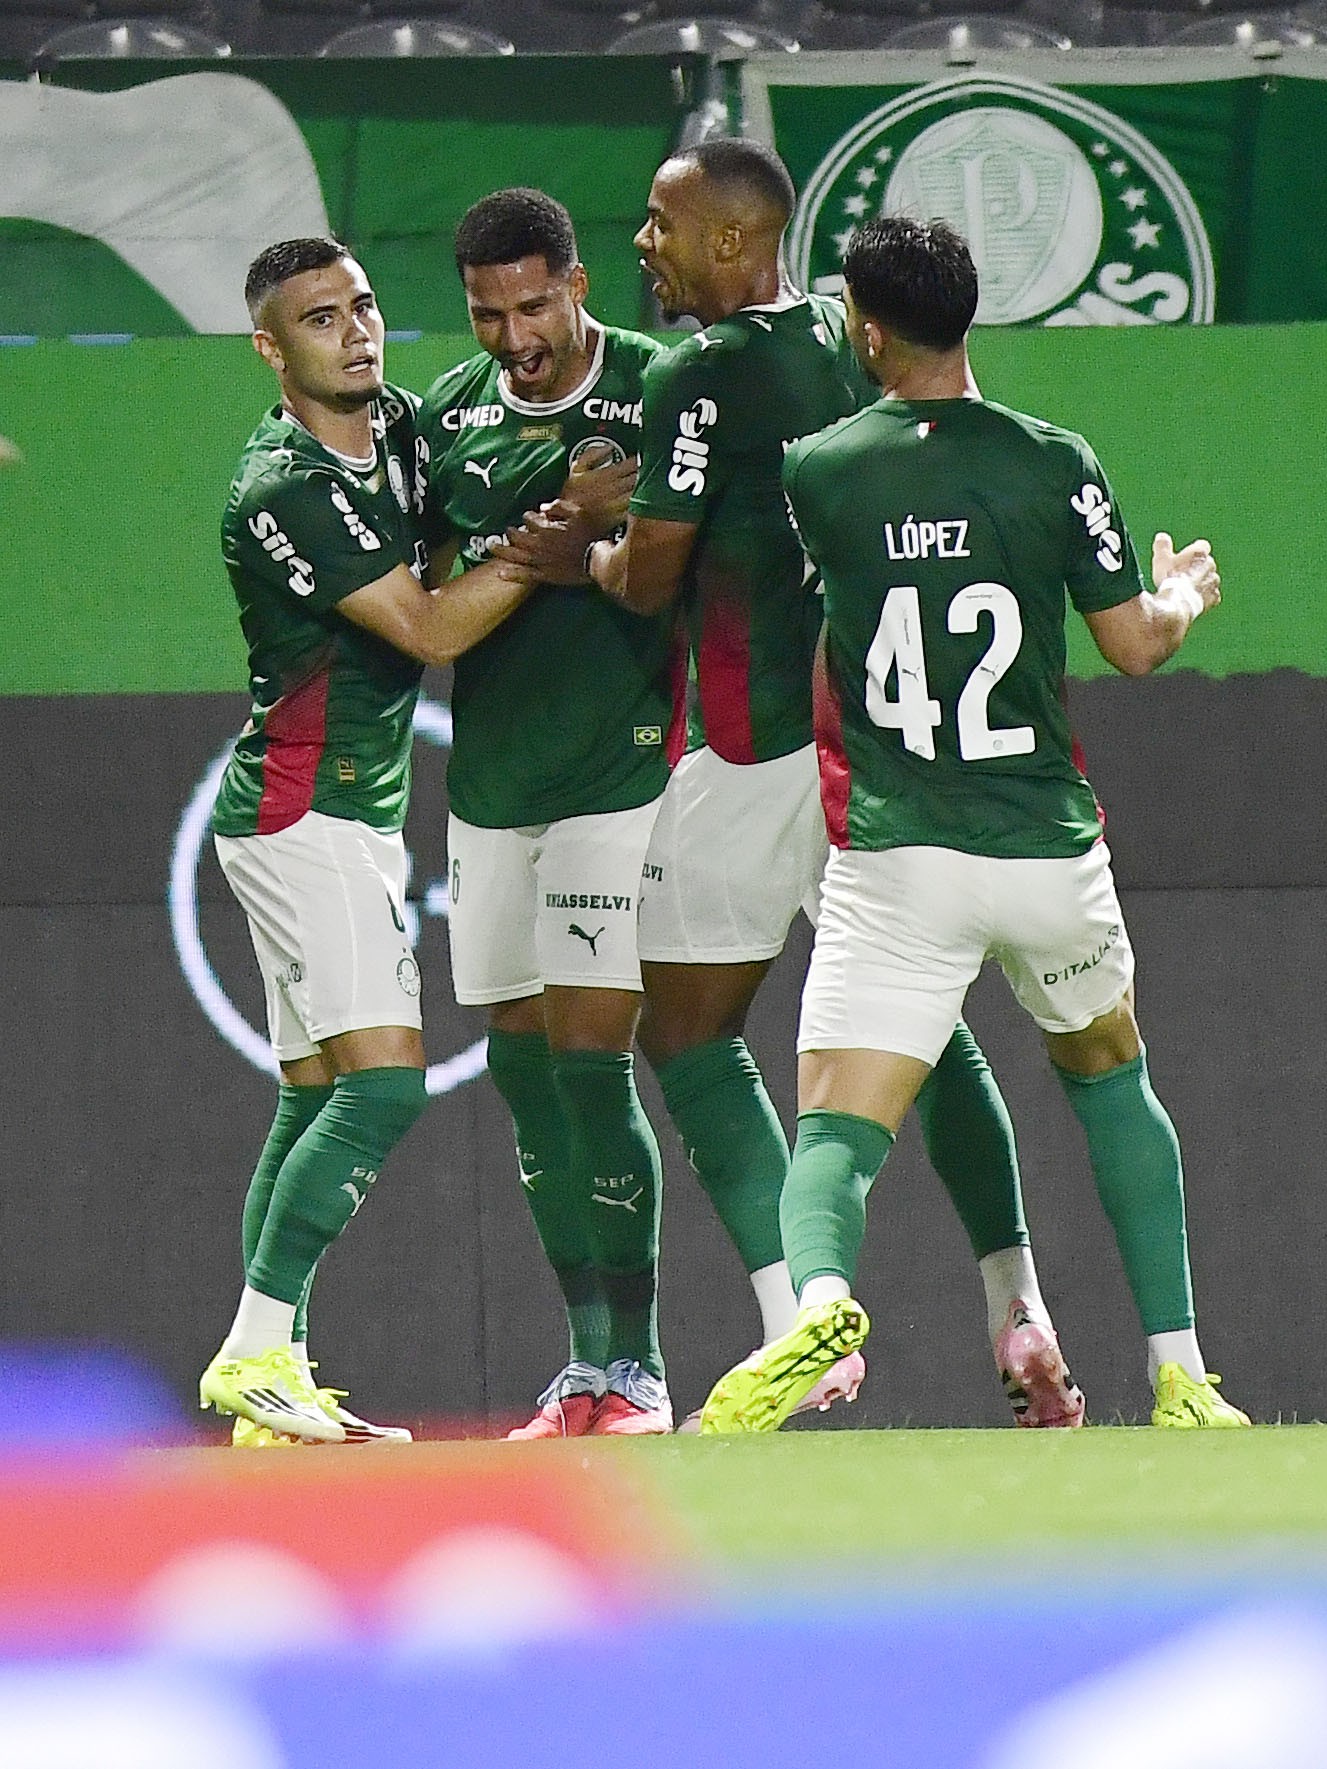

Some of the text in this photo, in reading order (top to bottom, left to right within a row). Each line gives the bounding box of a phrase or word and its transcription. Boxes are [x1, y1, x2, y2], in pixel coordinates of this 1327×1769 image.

[441, 404, 505, 430] CIMED
[884, 514, 971, 560] LÓPEZ
[865, 582, 1036, 761] 42
[452, 858, 461, 905] 6
